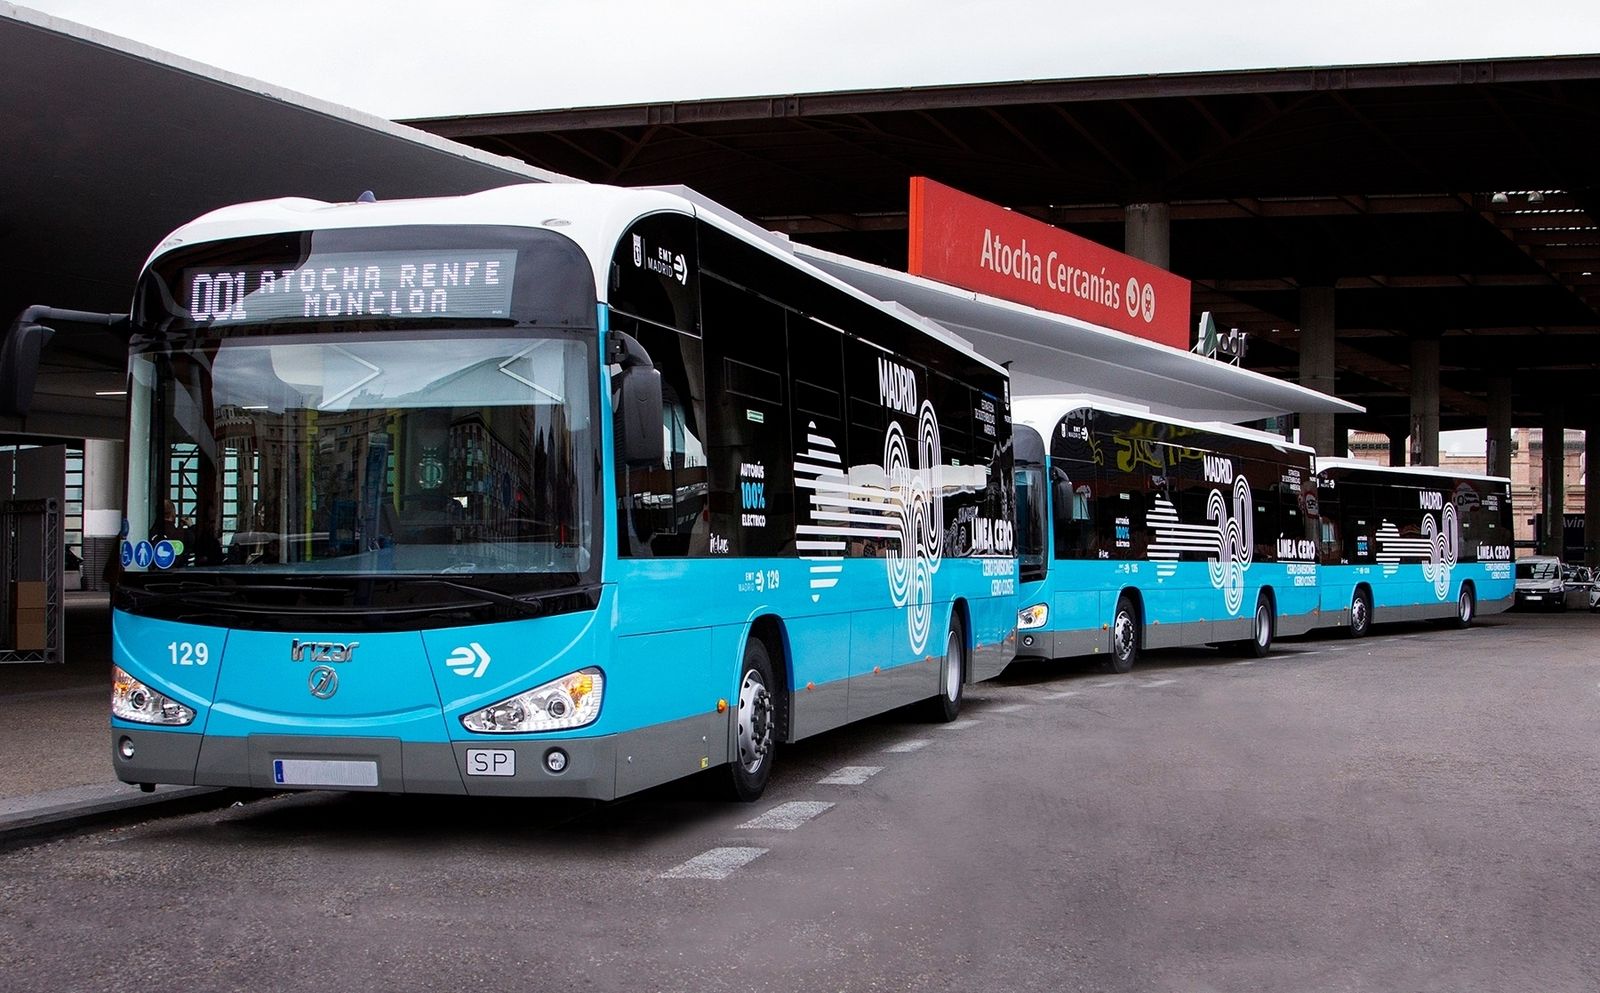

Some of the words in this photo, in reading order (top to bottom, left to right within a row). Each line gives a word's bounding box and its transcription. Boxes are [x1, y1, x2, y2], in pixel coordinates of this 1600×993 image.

[648, 256, 673, 277] MADRID
[658, 247, 672, 263] EMT
[980, 228, 1042, 285] Atocha
[1046, 251, 1121, 310] Cercanías
[259, 265, 381, 293] ATOCHA
[400, 261, 500, 287] RENFE
[190, 272, 247, 321] 001
[304, 289, 447, 317] MONCLOA
[877, 356, 918, 415] MADRID
[740, 460, 765, 479] AUTOBÚS
[1203, 454, 1233, 485] MADRID
[741, 481, 766, 509] 100%
[1419, 490, 1443, 510] MADRID
[971, 505, 994, 550] LÍNEA
[994, 518, 1014, 551] CERO
[1276, 532, 1298, 559] LÍNEA
[1298, 539, 1316, 560] CERO
[1476, 541, 1495, 560] LÍNEA
[1495, 545, 1511, 560] CERO
[766, 569, 780, 590] 129
[167, 641, 209, 666] 129
[473, 752, 509, 772] SP
